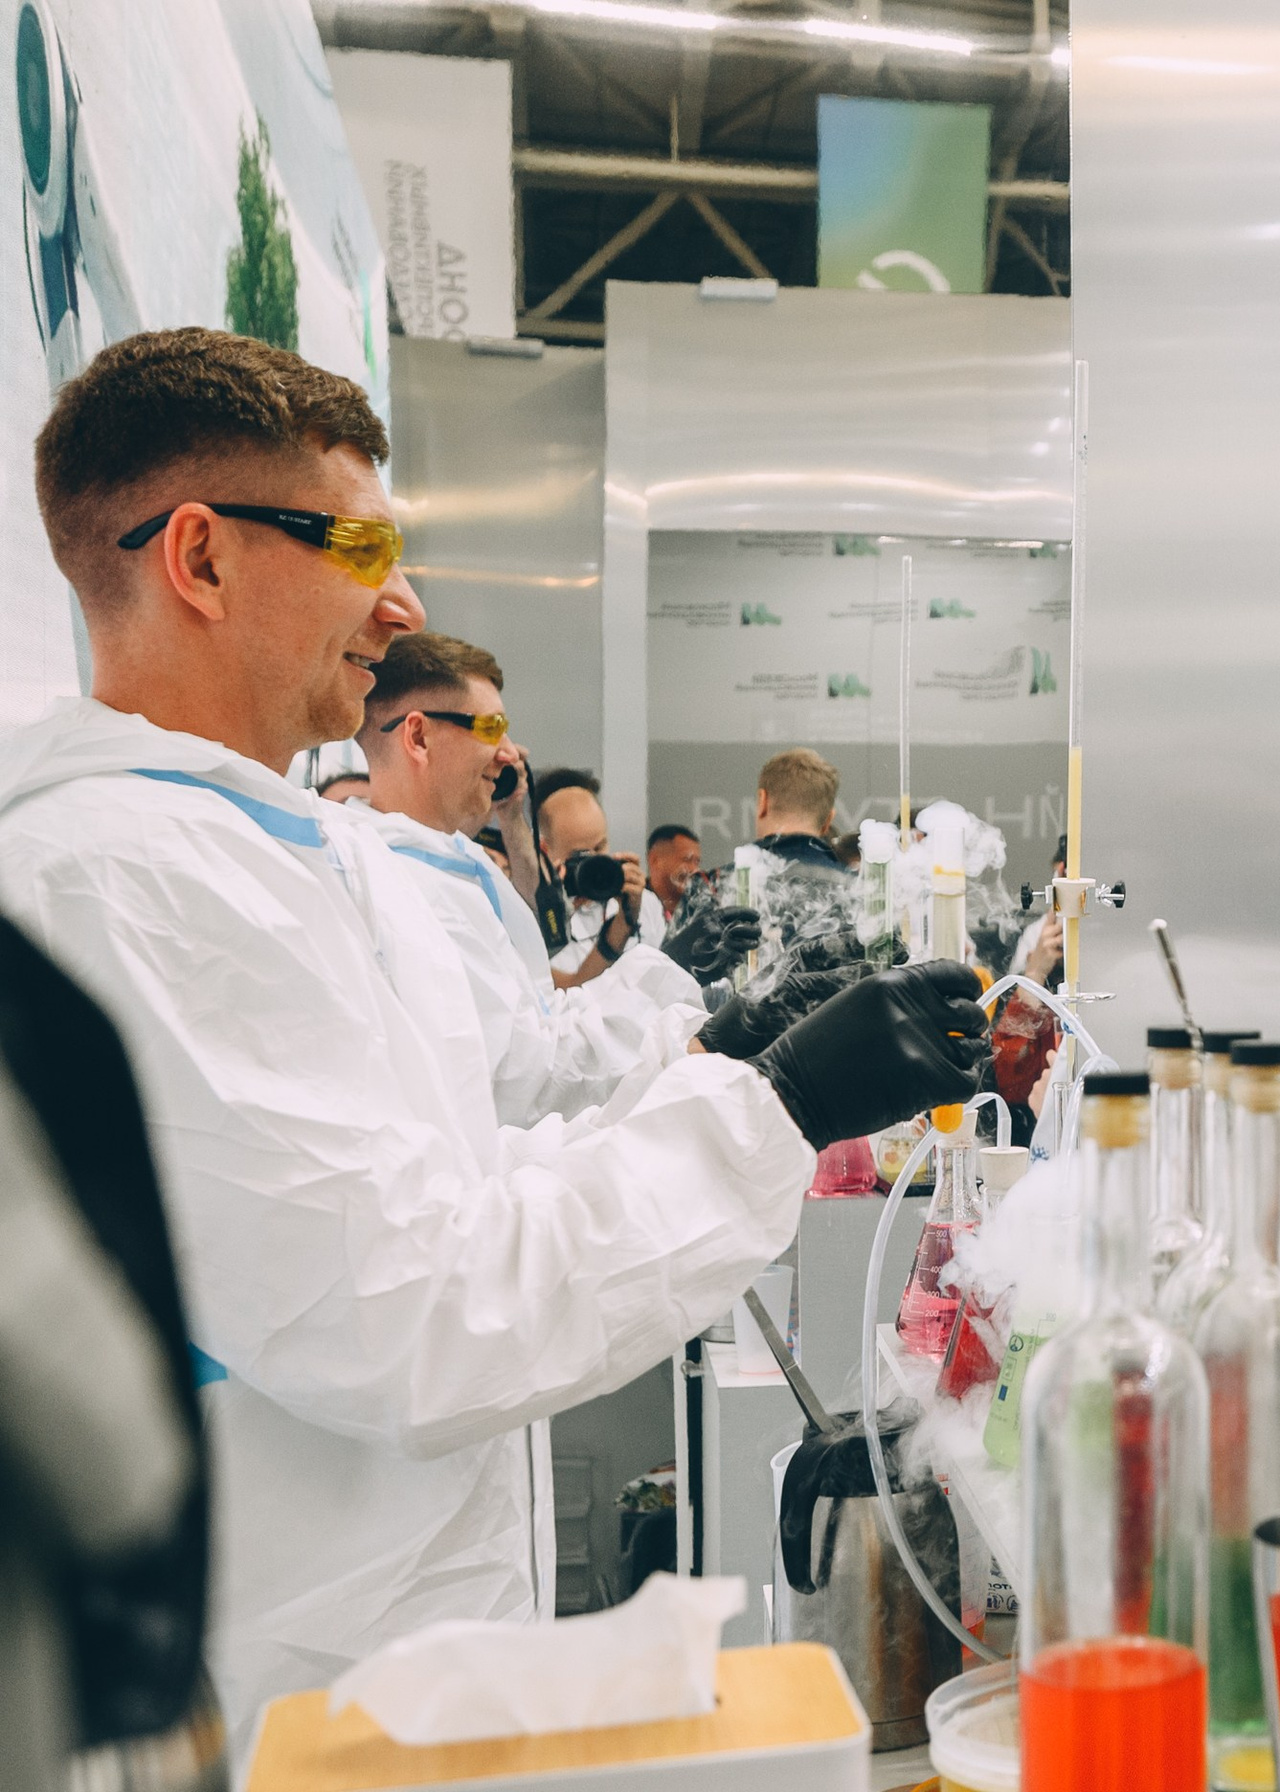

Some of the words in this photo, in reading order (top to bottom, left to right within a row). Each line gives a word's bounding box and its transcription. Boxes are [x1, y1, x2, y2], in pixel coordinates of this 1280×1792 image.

[935, 1230, 948, 1239] 500
[930, 1265, 942, 1274] 400
[924, 1309, 940, 1318] 200
